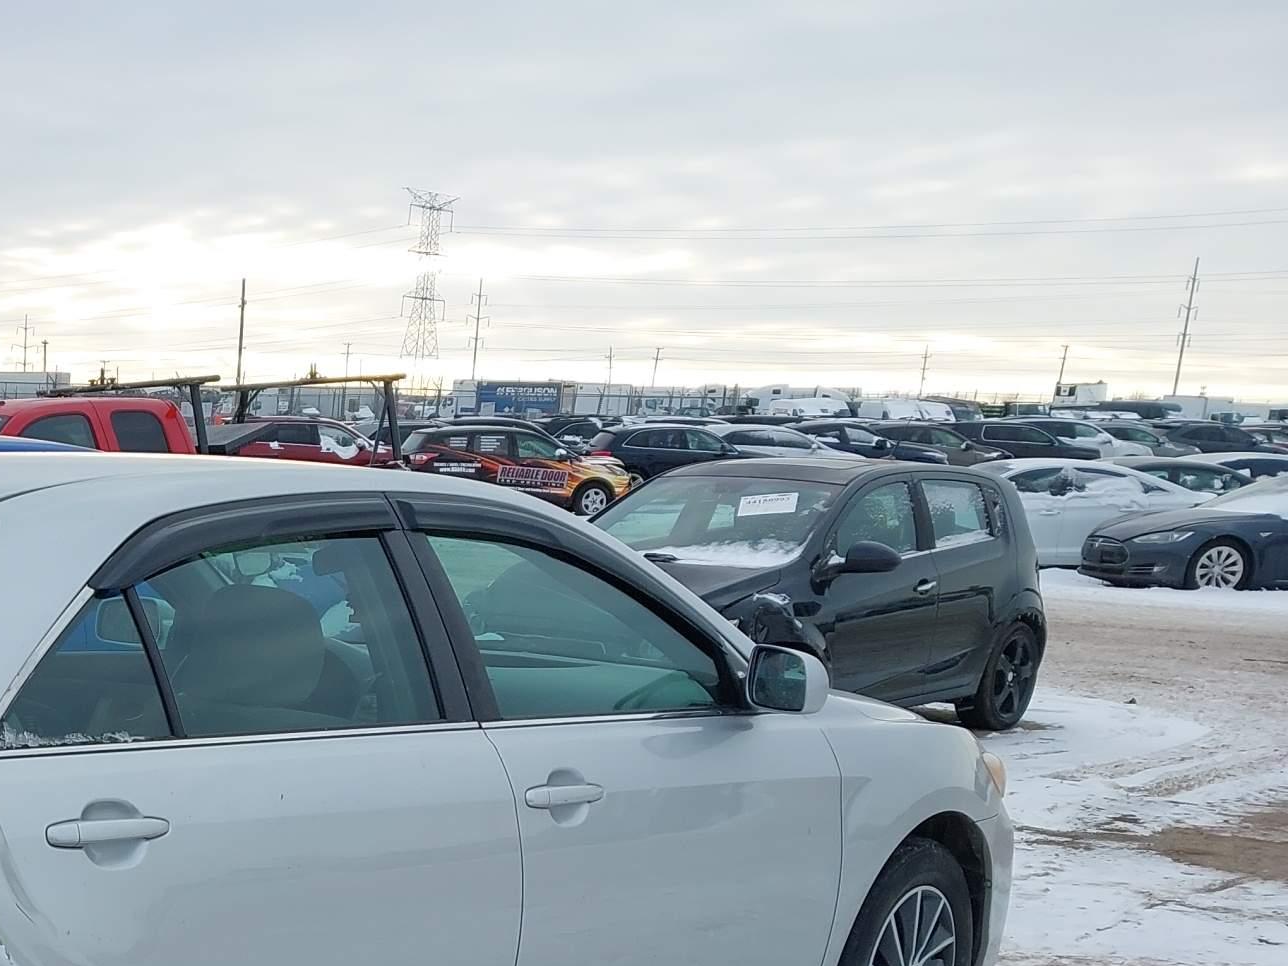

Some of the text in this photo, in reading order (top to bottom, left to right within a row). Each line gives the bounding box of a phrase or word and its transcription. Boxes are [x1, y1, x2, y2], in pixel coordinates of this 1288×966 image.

[505, 387, 557, 397] FERGUSON
[499, 466, 541, 480] RELIABLE
[541, 470, 568, 483] DOOR
